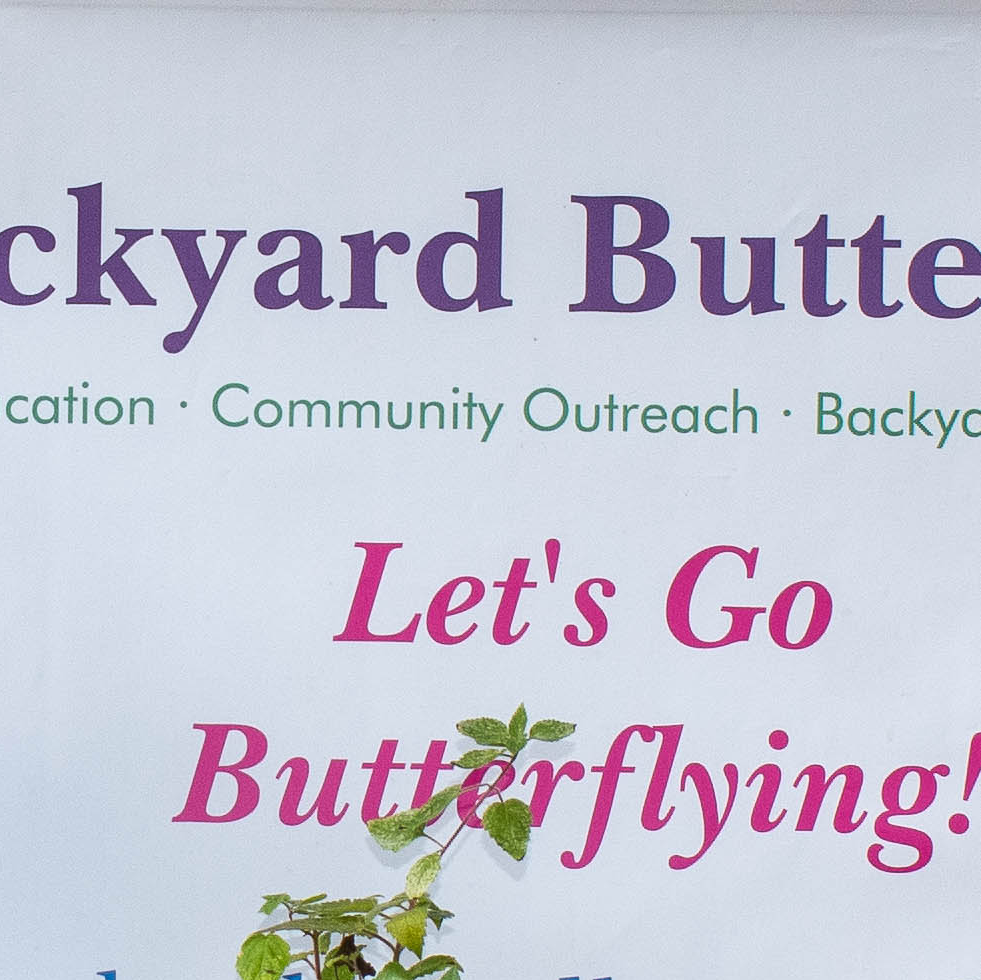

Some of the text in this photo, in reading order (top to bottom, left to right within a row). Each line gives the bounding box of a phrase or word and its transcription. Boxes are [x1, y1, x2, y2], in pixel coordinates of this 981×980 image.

[569, 194, 981, 319] Butte
[212, 383, 504, 442] Community
[523, 387, 758, 432] Outreach
[333, 538, 833, 650] Let's Go
[172, 722, 981, 874] Butterflying!
